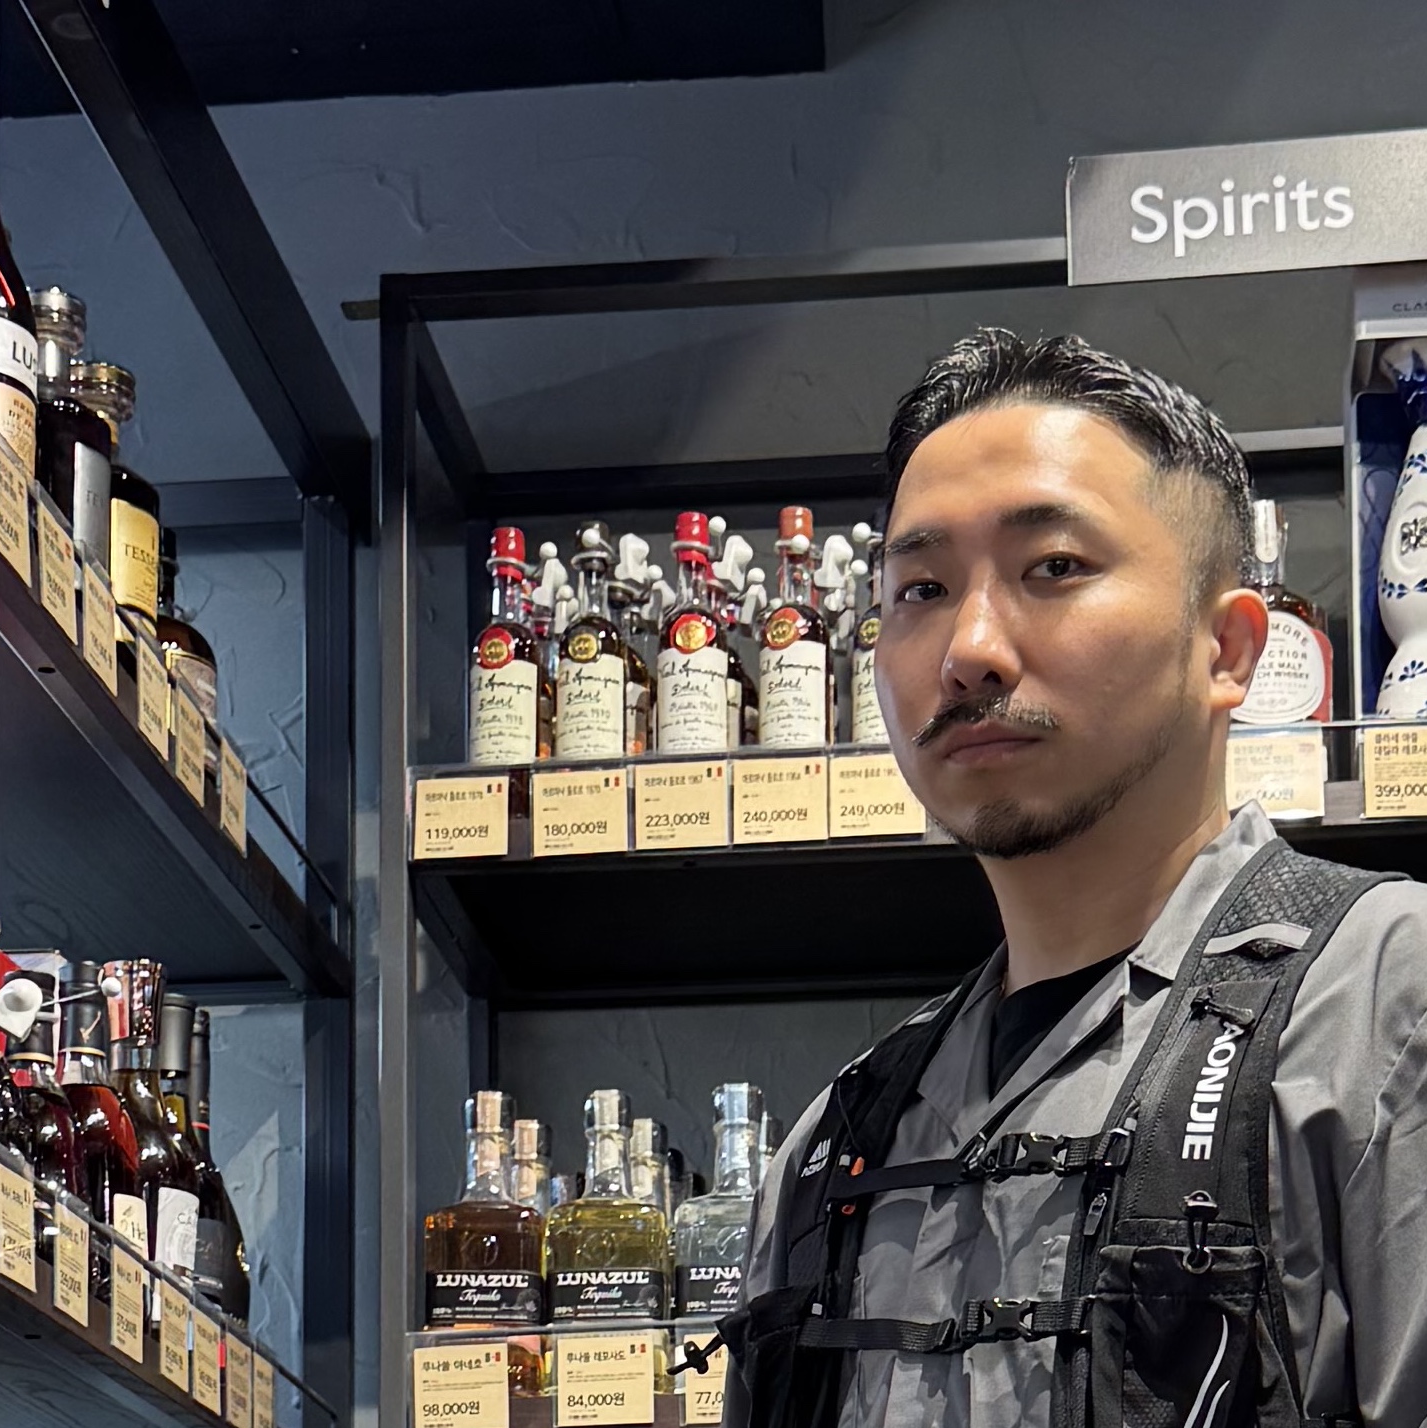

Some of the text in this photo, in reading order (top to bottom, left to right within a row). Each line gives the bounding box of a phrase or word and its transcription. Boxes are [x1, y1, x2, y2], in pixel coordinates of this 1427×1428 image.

[1128, 173, 1355, 257] Spirits
[742, 807, 808, 825] 240,000원
[839, 802, 905, 818] 249,000원
[644, 811, 711, 828] 223,000원
[424, 825, 489, 841] 119,000원
[543, 820, 608, 837] 180,000원
[1181, 1018, 1245, 1163] AONIJE
[435, 1272, 529, 1289] LUNAZUL
[556, 1270, 651, 1287] LUNAZUL
[567, 1391, 626, 1408] 84,000원
[422, 1401, 480, 1417] 98,000원
